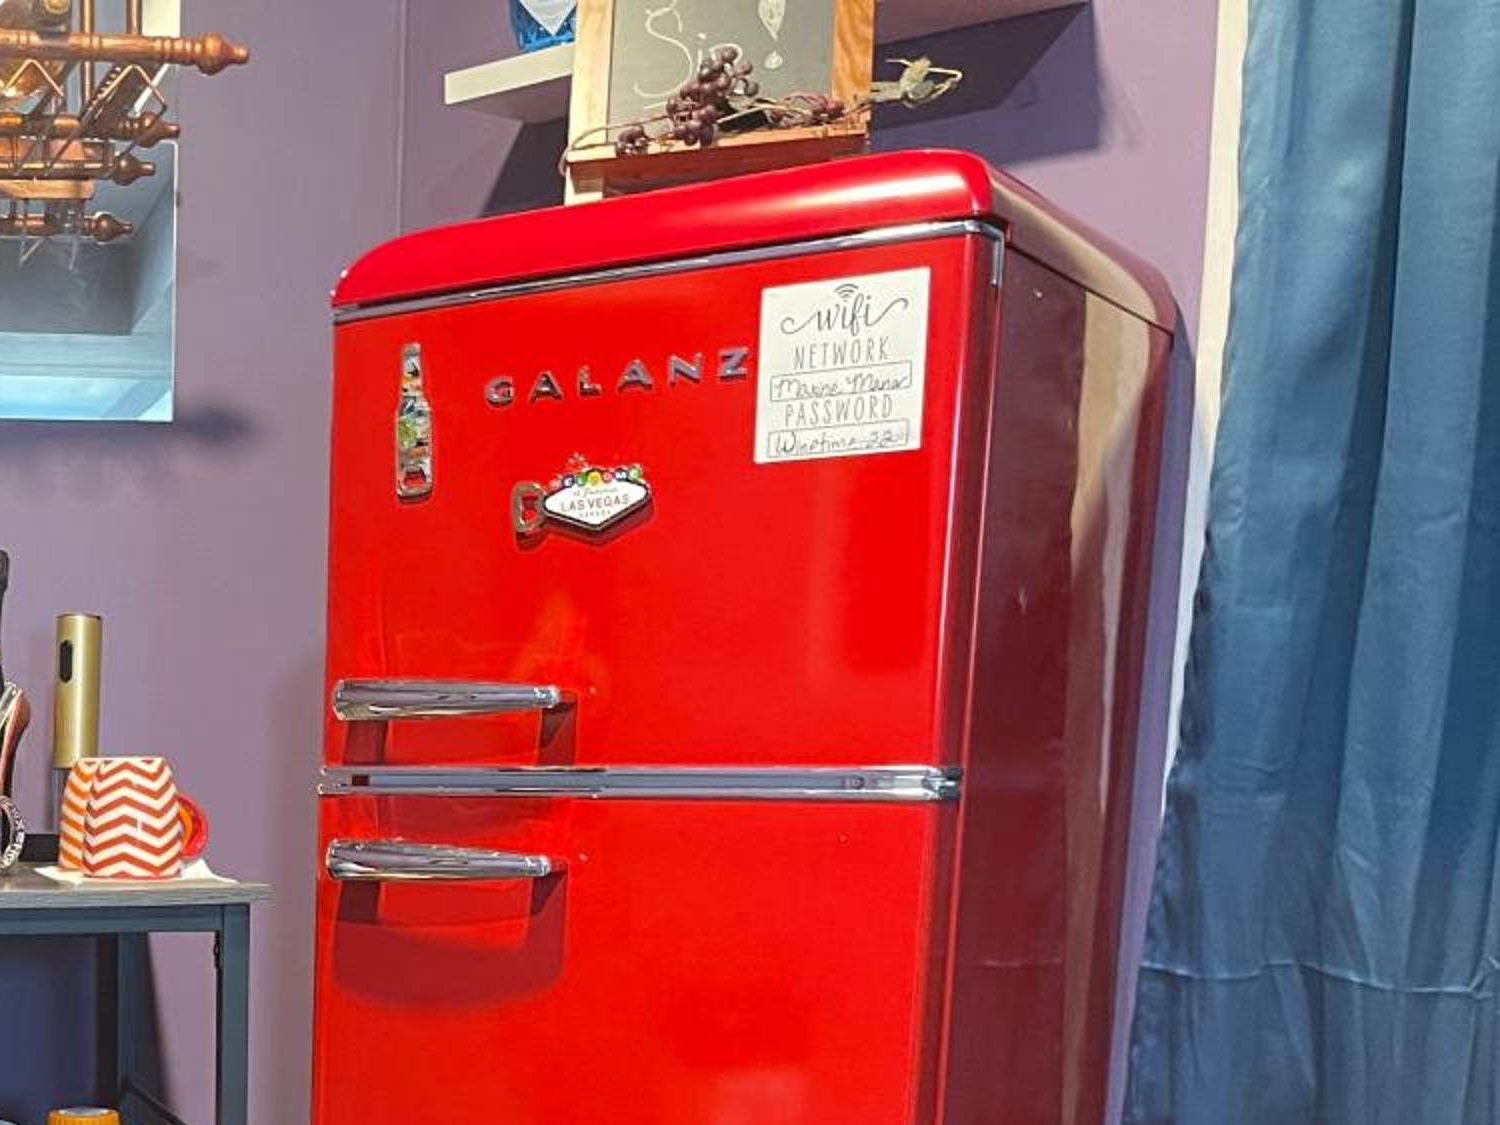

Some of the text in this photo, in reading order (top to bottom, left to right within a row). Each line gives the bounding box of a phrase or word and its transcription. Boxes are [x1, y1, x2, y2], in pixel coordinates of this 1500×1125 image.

[793, 336, 890, 370] NETWORK
[484, 346, 749, 410] GALANZ
[784, 393, 893, 428] PASSWORD
[560, 493, 630, 513] LAS VEGAS
